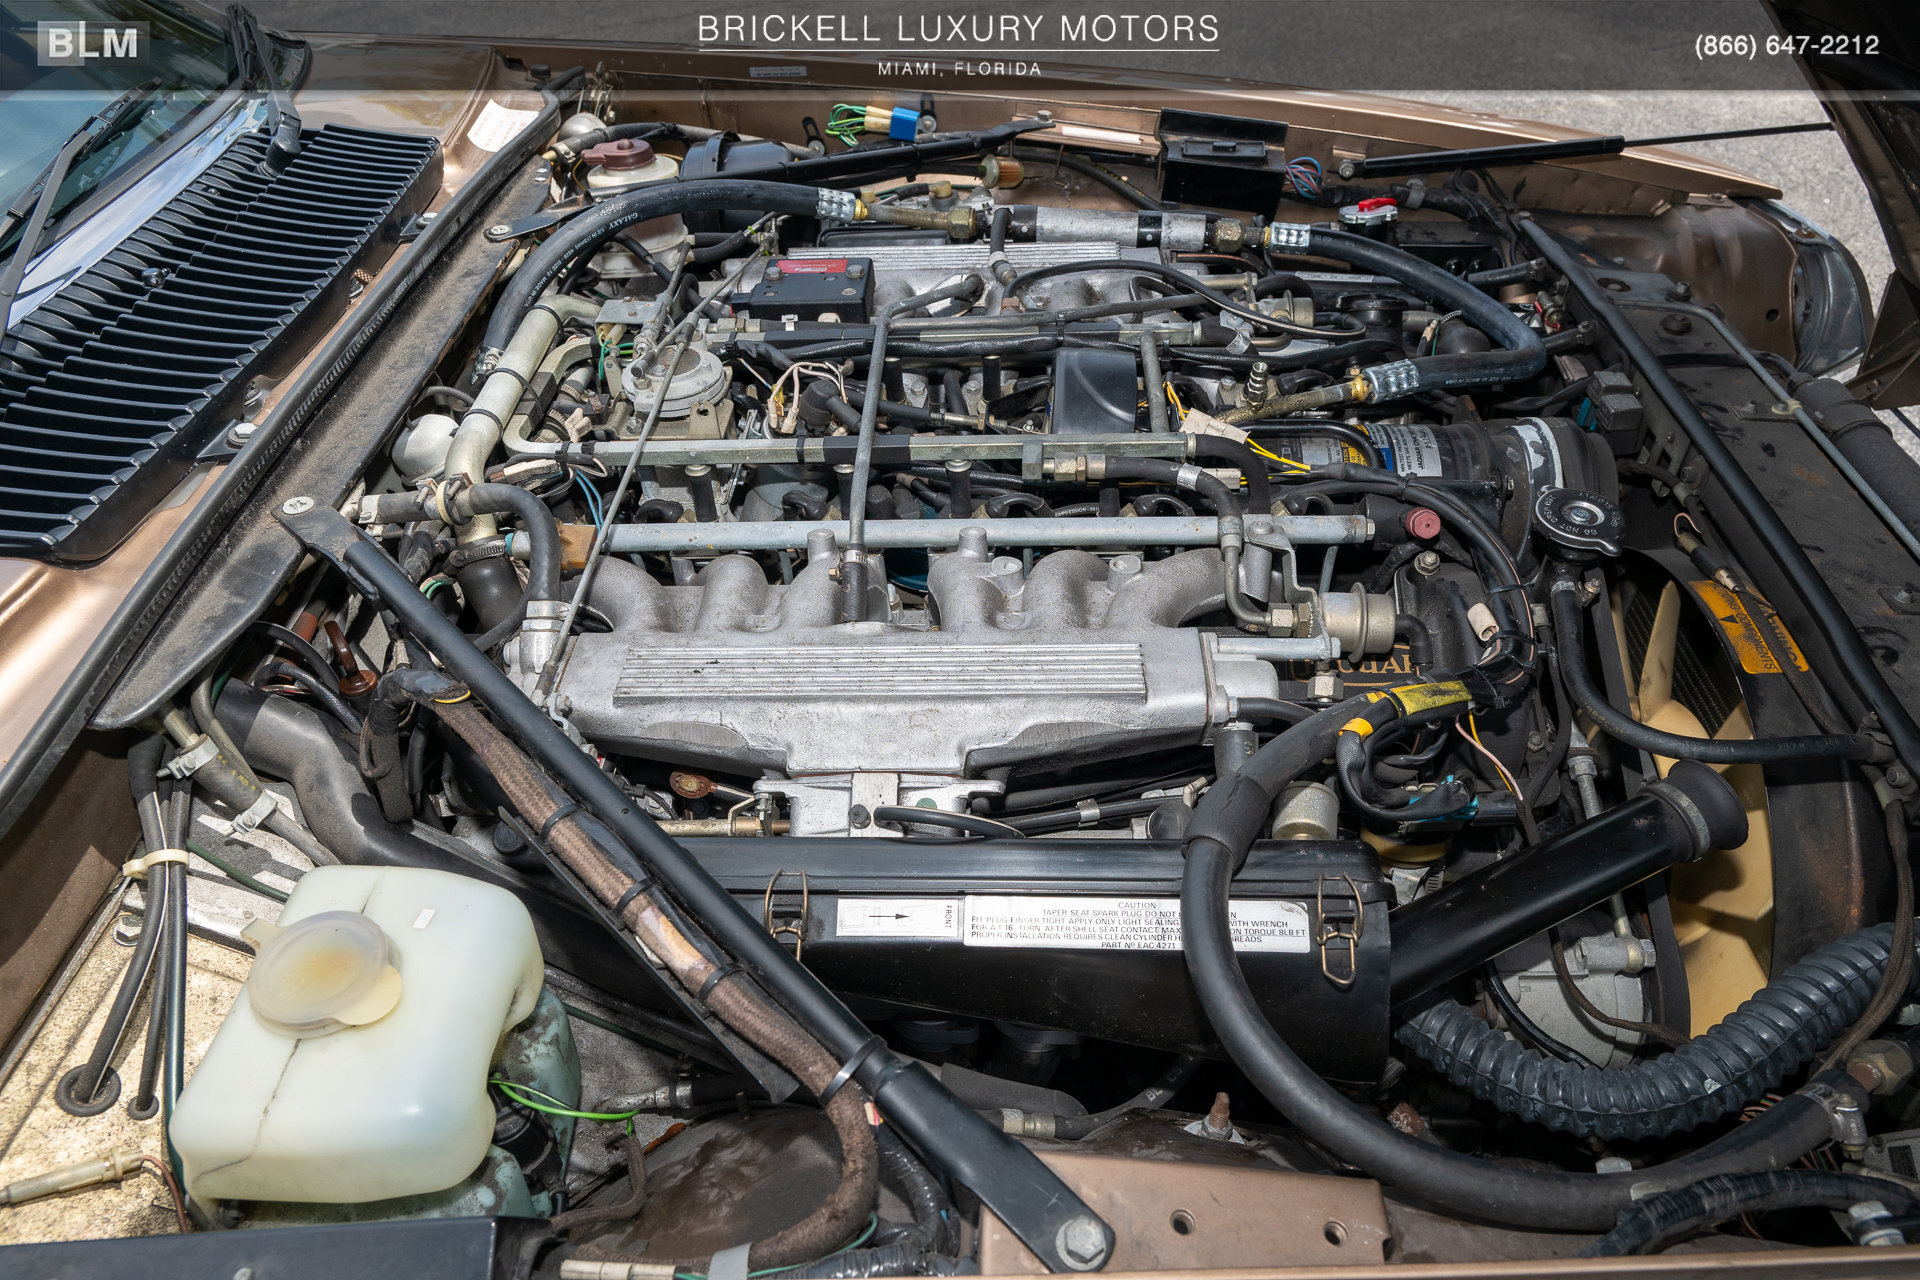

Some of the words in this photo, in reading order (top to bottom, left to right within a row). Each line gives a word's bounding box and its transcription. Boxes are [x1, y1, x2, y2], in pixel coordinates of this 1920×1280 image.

[608, 212, 639, 231] GALAXY
[1118, 901, 1157, 909] CAUTION
[944, 904, 952, 929] FRONT
[1070, 909, 1090, 917] SEAT
[1010, 916, 1040, 924] FINGER
[1095, 918, 1116, 926] ONLY
[1251, 920, 1288, 928] WRENCH
[1244, 928, 1277, 936] TORQUE
[1101, 941, 1122, 949] PART
